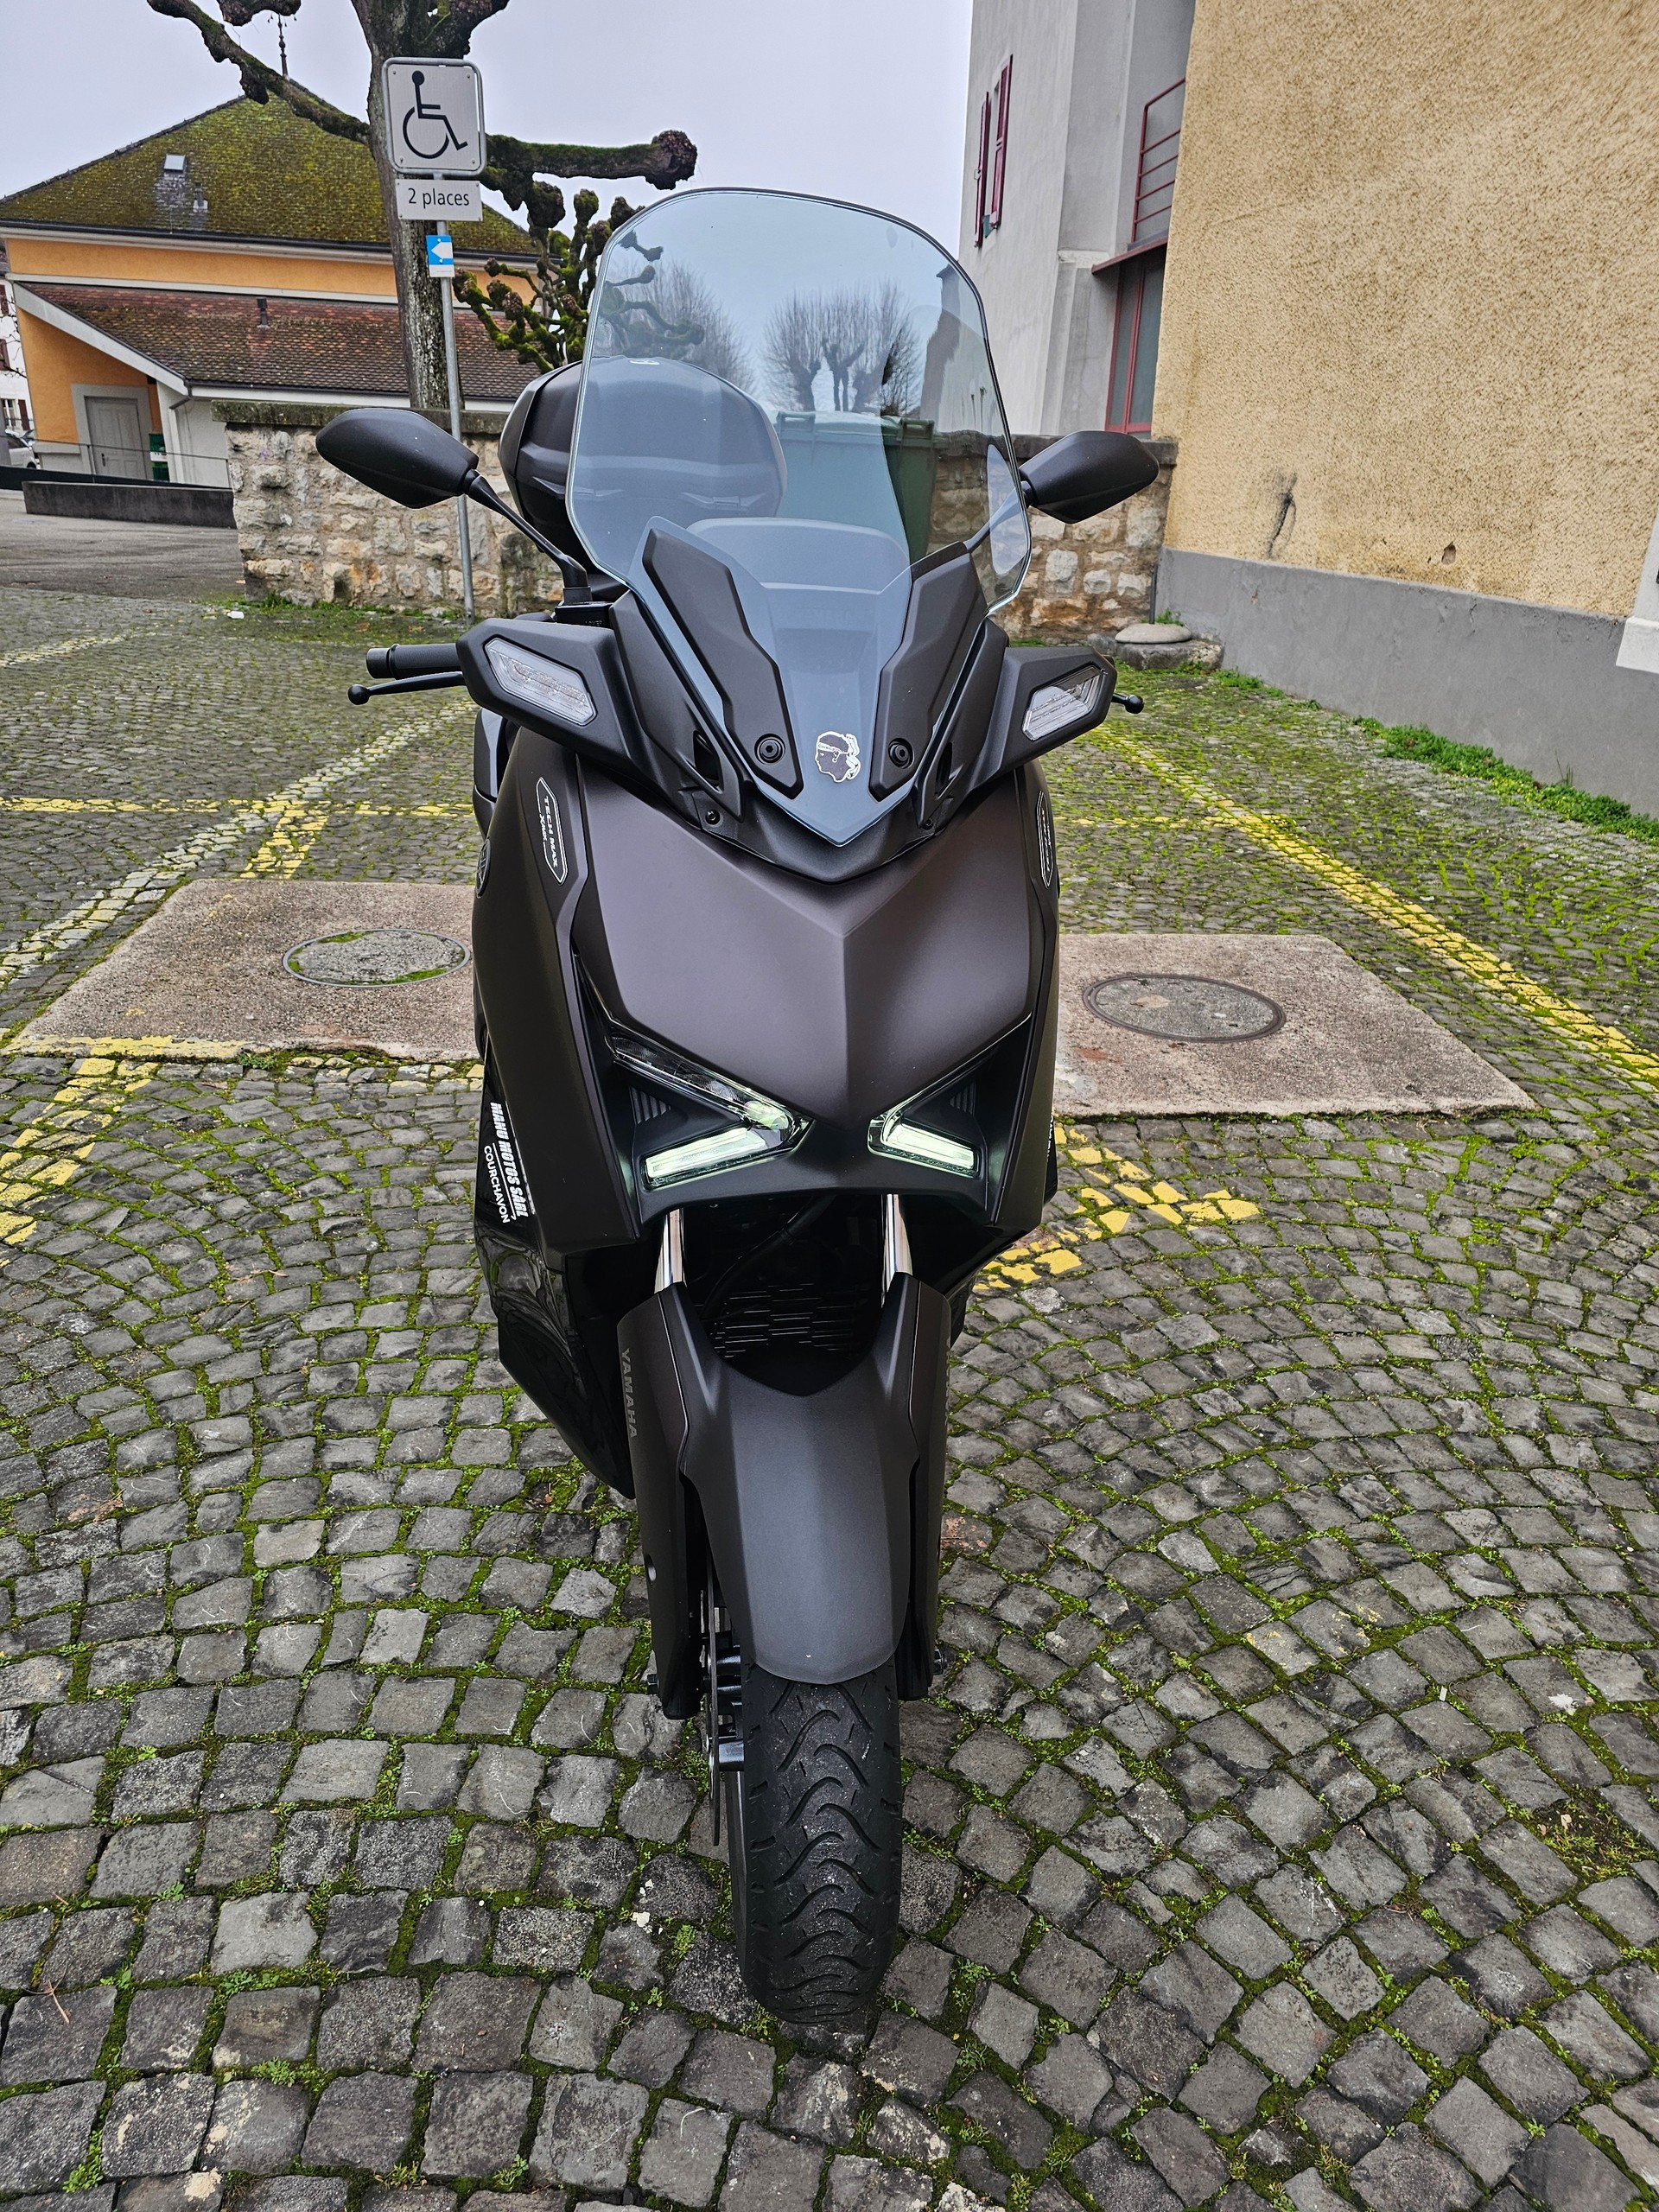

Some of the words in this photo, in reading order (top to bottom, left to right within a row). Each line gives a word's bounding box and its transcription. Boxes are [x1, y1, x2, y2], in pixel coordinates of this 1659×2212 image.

[408, 188, 416, 204] 2
[423, 188, 470, 209] places
[544, 796, 554, 835] TECH
[550, 837, 558, 868] MAX
[490, 1102, 509, 1140] MANU
[484, 1145, 511, 1224] COURCHAVON
[498, 1140, 520, 1185] MOTOS
[621, 1348, 638, 1438] YAMAHA
